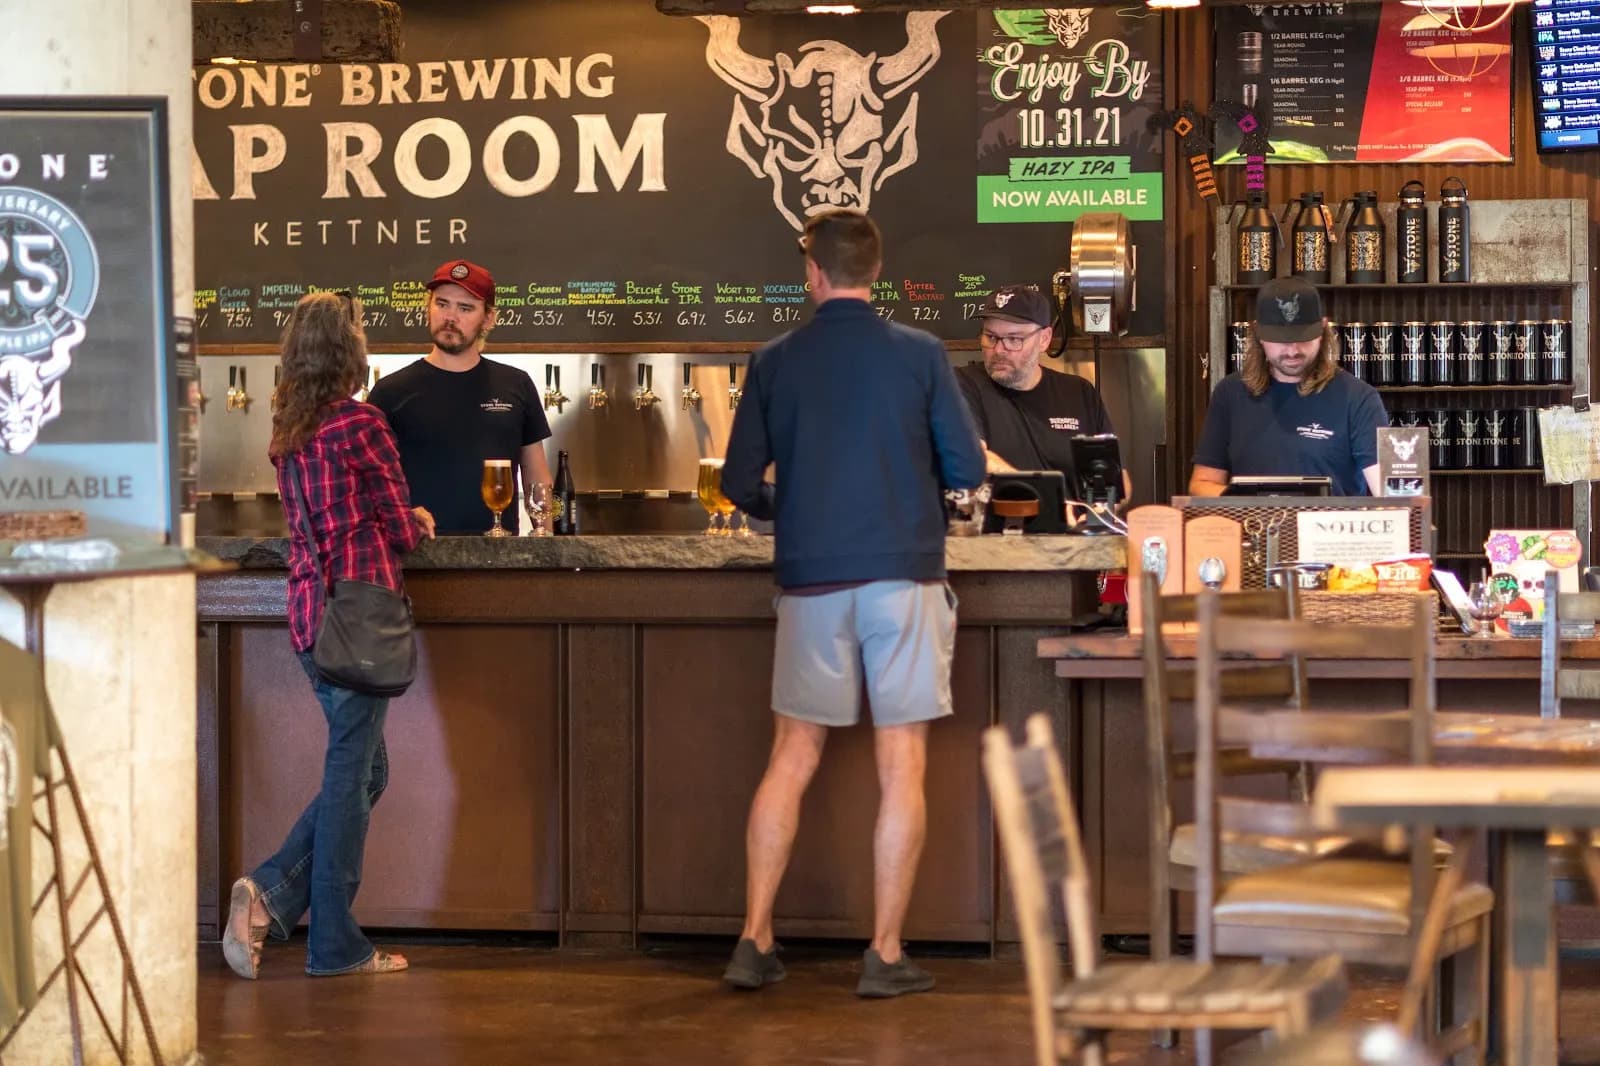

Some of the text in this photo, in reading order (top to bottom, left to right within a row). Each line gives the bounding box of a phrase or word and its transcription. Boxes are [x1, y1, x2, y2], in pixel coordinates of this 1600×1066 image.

[1273, 7, 1344, 17] BREWING
[340, 52, 616, 106] BREWING
[986, 41, 1082, 104] Enjoy
[1017, 106, 1121, 148] 10.31.21
[321, 113, 668, 200] ROOM
[1022, 160, 1116, 176] HAZY IPA
[992, 188, 1149, 208] NOW AVAILABLE
[254, 219, 469, 247] KETTNER
[1406, 217, 1416, 258] STONE
[1447, 217, 1457, 258] STONE
[261, 284, 305, 297] IMPERIAL
[358, 284, 386, 295] STONE
[527, 283, 562, 295] GARDEN
[671, 281, 703, 295] STONE
[716, 282, 757, 295] WORT TO
[763, 284, 804, 294] XOCAVEZA
[904, 279, 936, 291] BITTER
[527, 295, 567, 307] CRUSHER
[714, 295, 763, 304] YOUR MADRE
[908, 290, 945, 303] BASTARD
[632, 311, 663, 327] 5.3%
[677, 310, 706, 326] 6.9%
[724, 309, 756, 325] 5.6%
[911, 307, 941, 321] 7.2%
[1343, 352, 1368, 361] STONE
[1370, 352, 1395, 361] STONE
[1401, 352, 1426, 361] STONE
[1430, 352, 1454, 361] STONE
[1483, 437, 1508, 446] STONE
[1315, 519, 1395, 535] NOTICE
